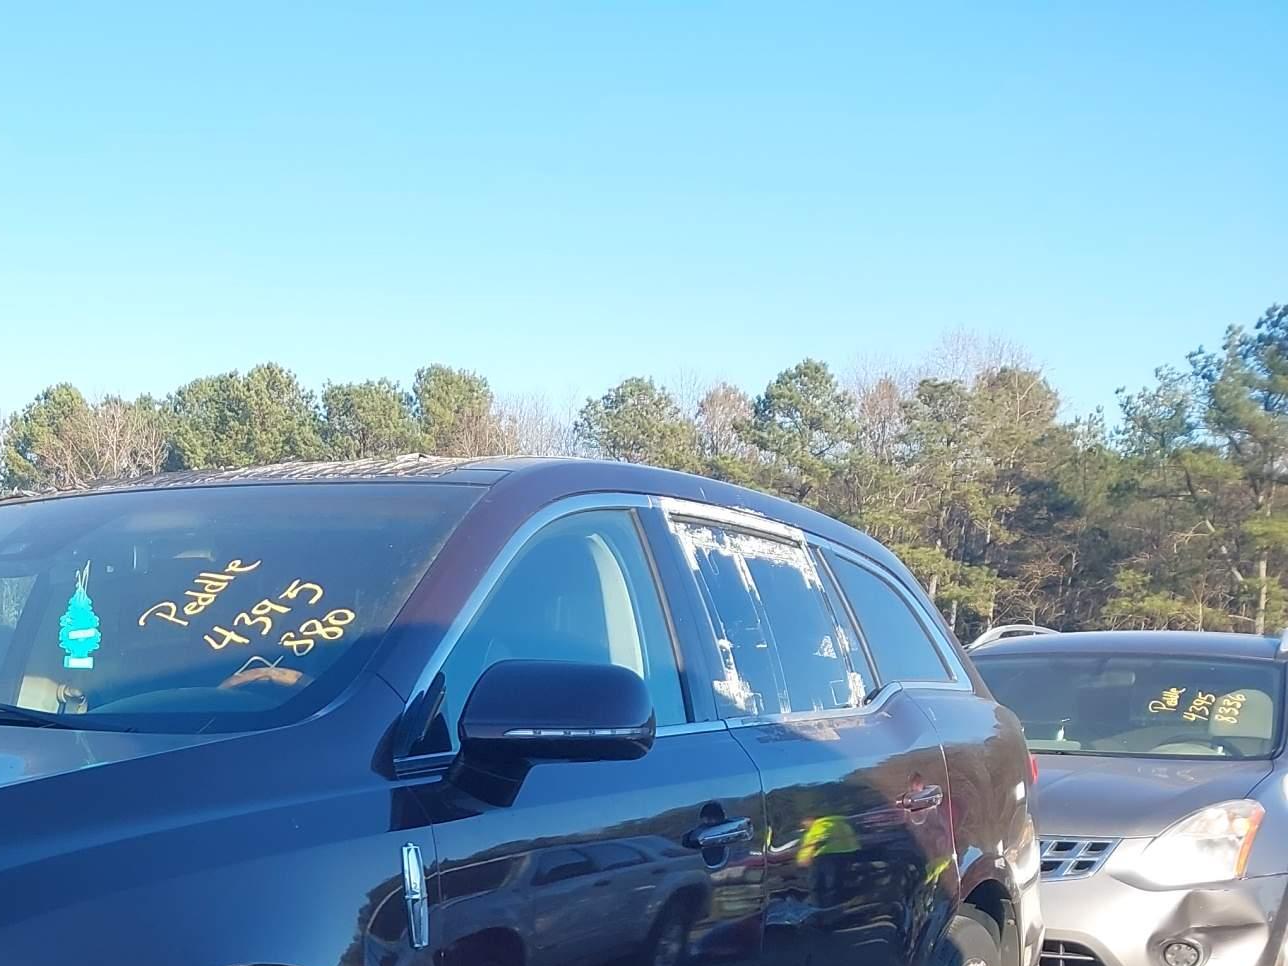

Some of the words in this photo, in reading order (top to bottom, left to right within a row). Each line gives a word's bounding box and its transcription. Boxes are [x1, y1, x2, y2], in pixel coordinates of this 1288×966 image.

[138, 558, 262, 627] Peddle
[203, 578, 324, 650] 4395
[1182, 691, 1216, 721] 4395
